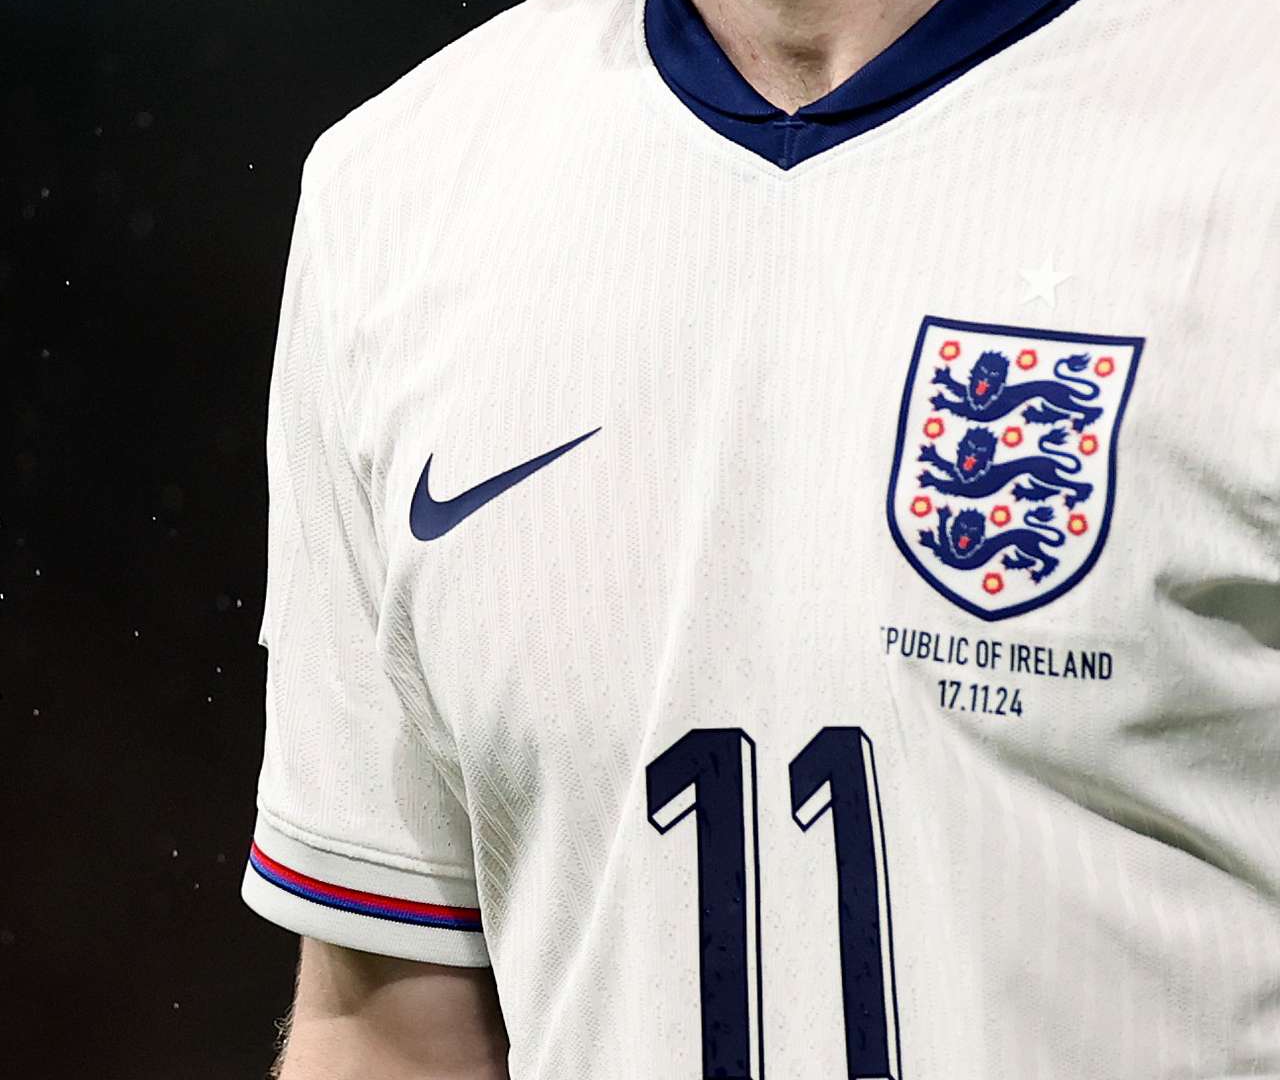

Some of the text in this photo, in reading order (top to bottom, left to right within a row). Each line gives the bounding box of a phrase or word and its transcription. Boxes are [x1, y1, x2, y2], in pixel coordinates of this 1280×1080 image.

[880, 627, 1113, 680] PUBLIC OF IRELAND
[937, 679, 1023, 717] 17.11.24
[645, 726, 903, 1080] 11
